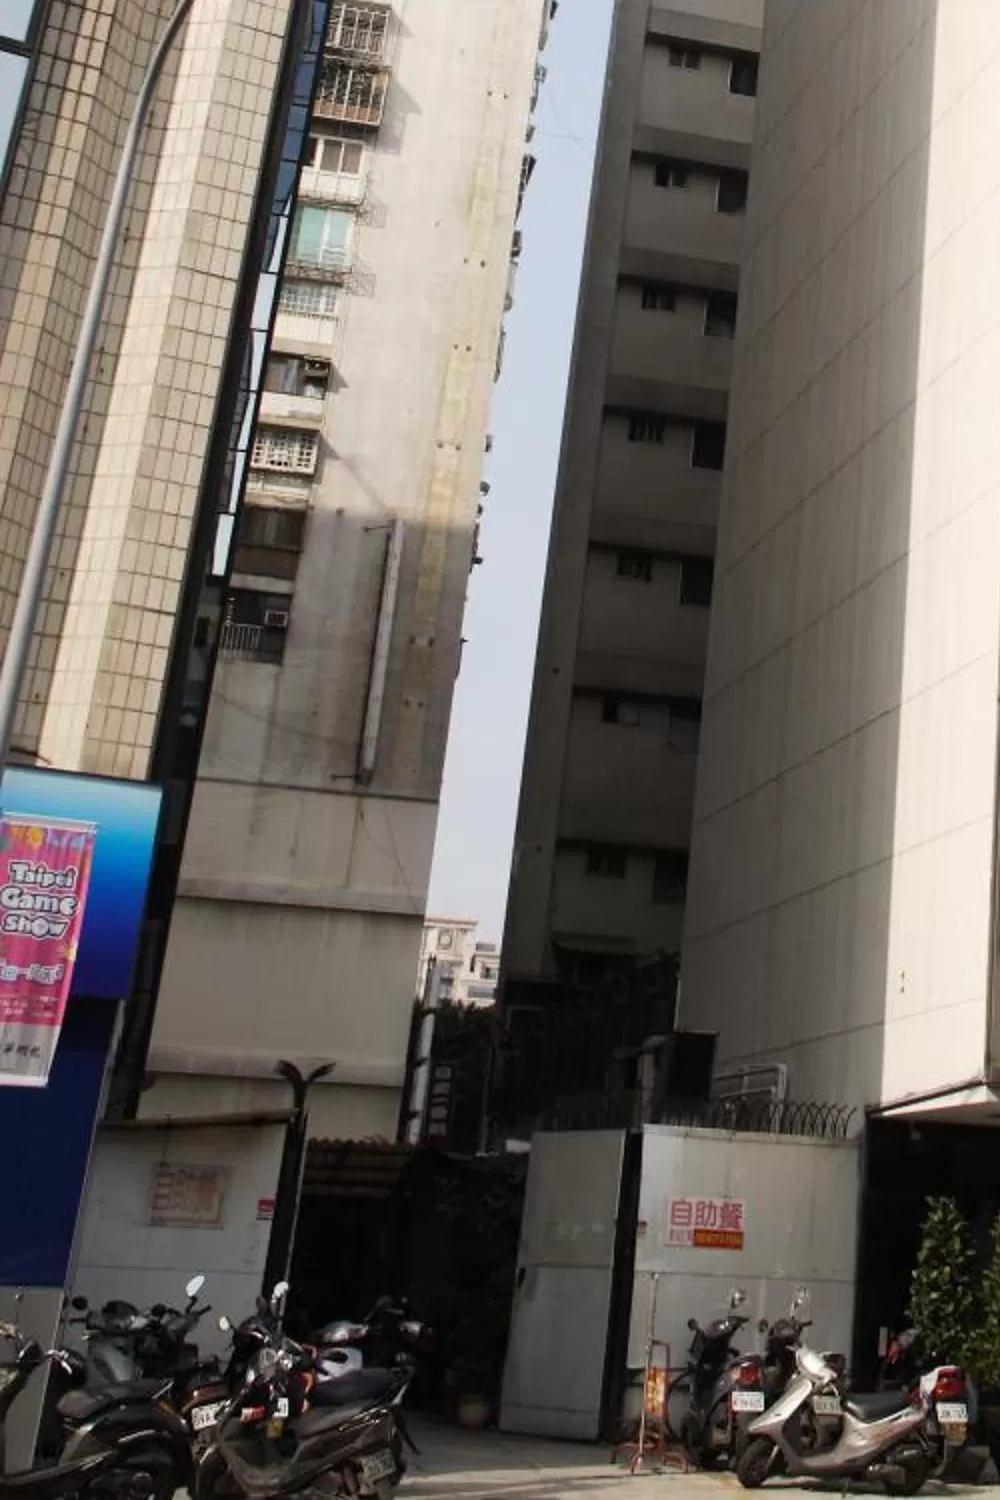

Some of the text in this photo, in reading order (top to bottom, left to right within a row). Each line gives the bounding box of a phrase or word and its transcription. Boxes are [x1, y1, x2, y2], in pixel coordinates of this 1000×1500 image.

[10, 862, 76, 888] Taipei
[1, 886, 77, 915] Game
[3, 913, 69, 938] Show
[671, 1199, 743, 1229] 自助餐
